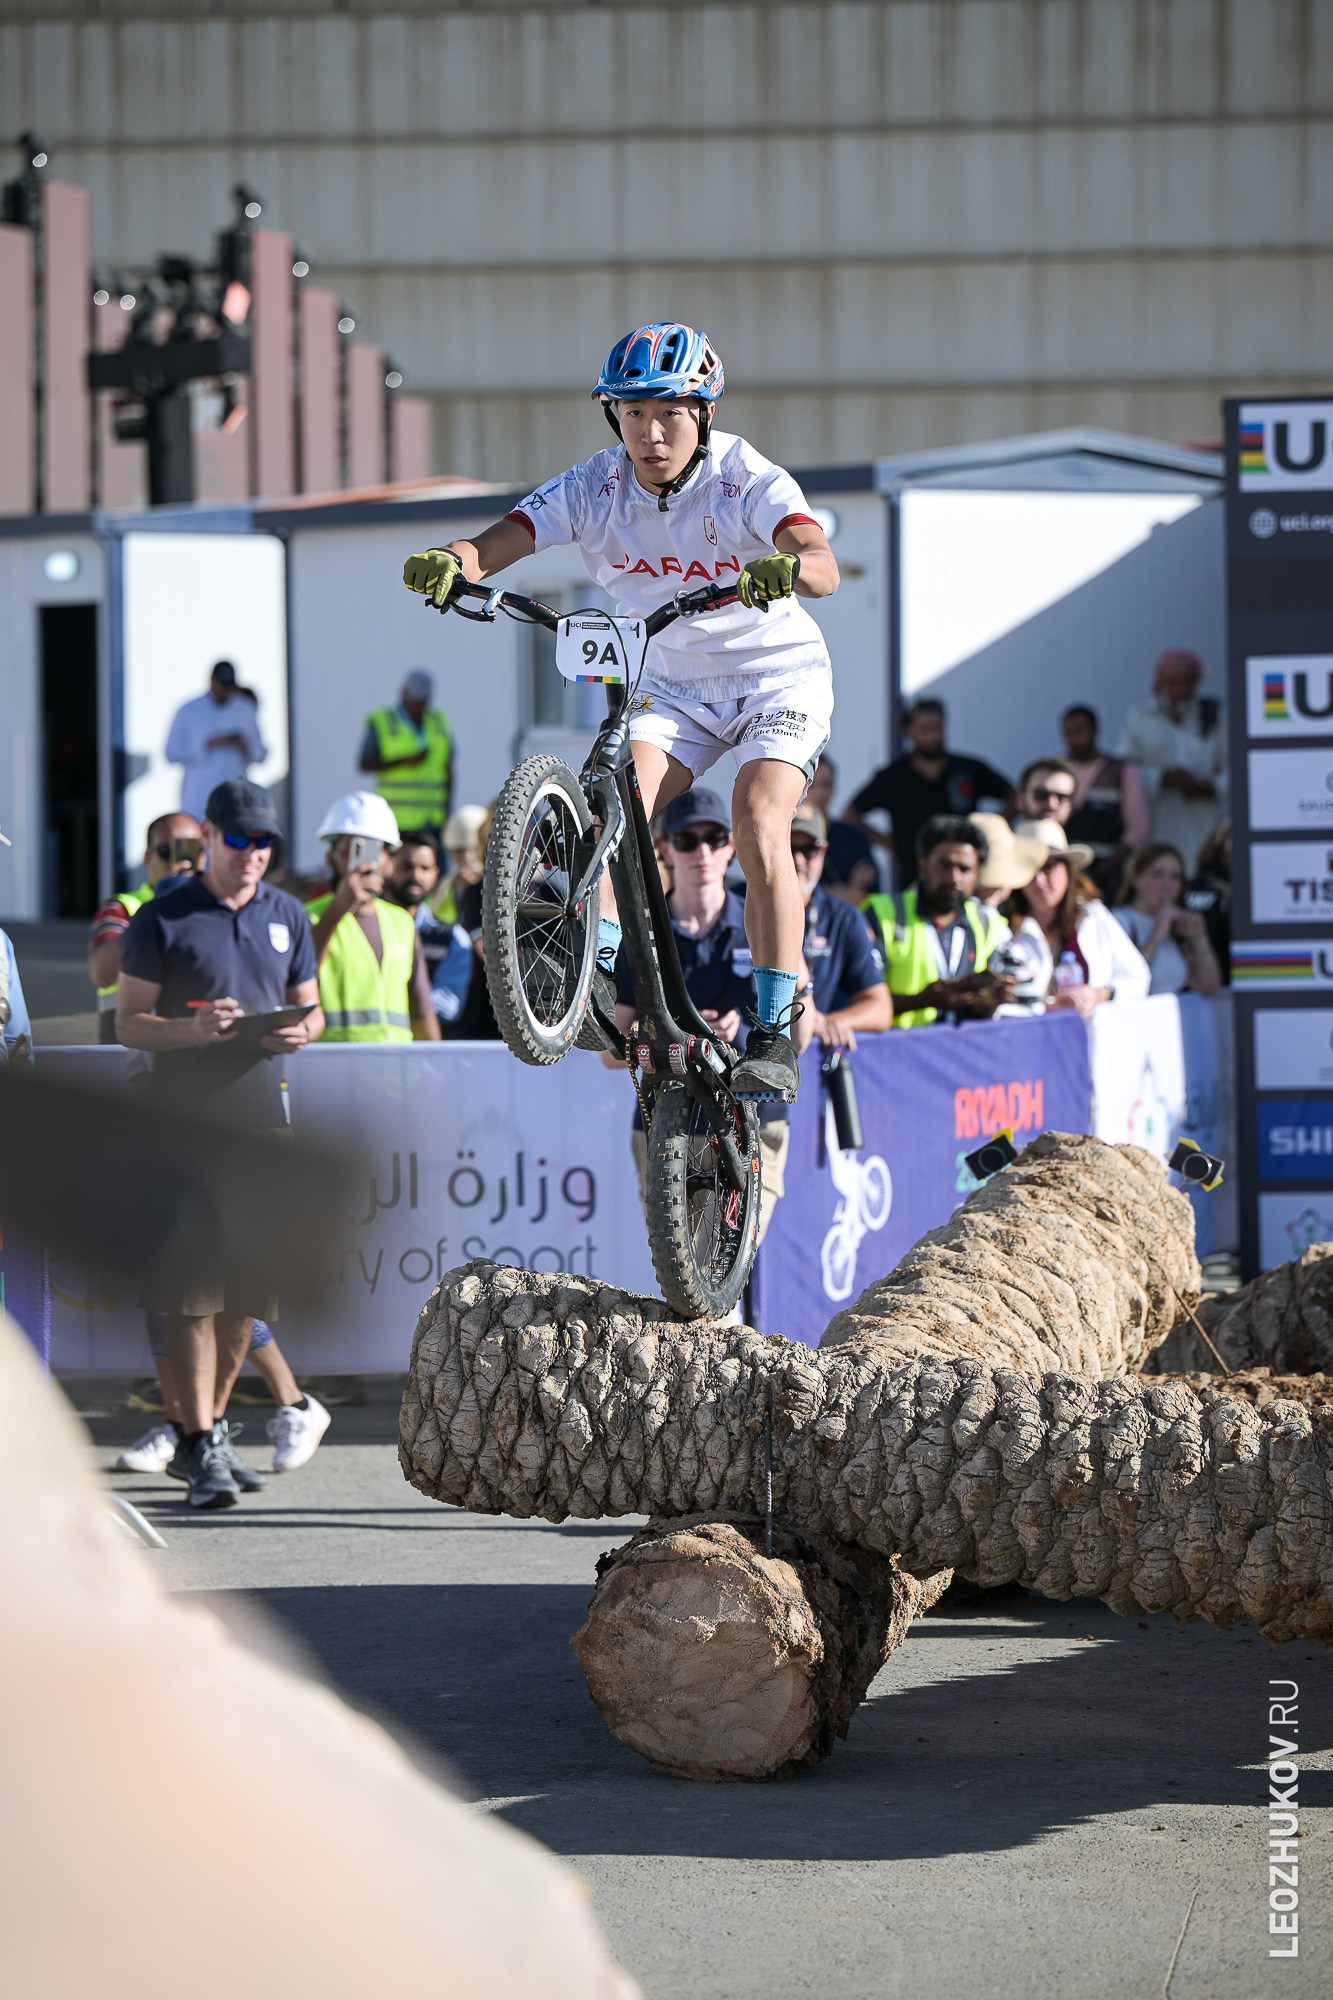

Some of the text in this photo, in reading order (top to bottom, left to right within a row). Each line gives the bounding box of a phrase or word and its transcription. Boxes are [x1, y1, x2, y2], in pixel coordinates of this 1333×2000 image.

[582, 640, 619, 666] 9A
[954, 1079, 1044, 1140] RIYADH
[448, 1150, 596, 1224] وزارة
